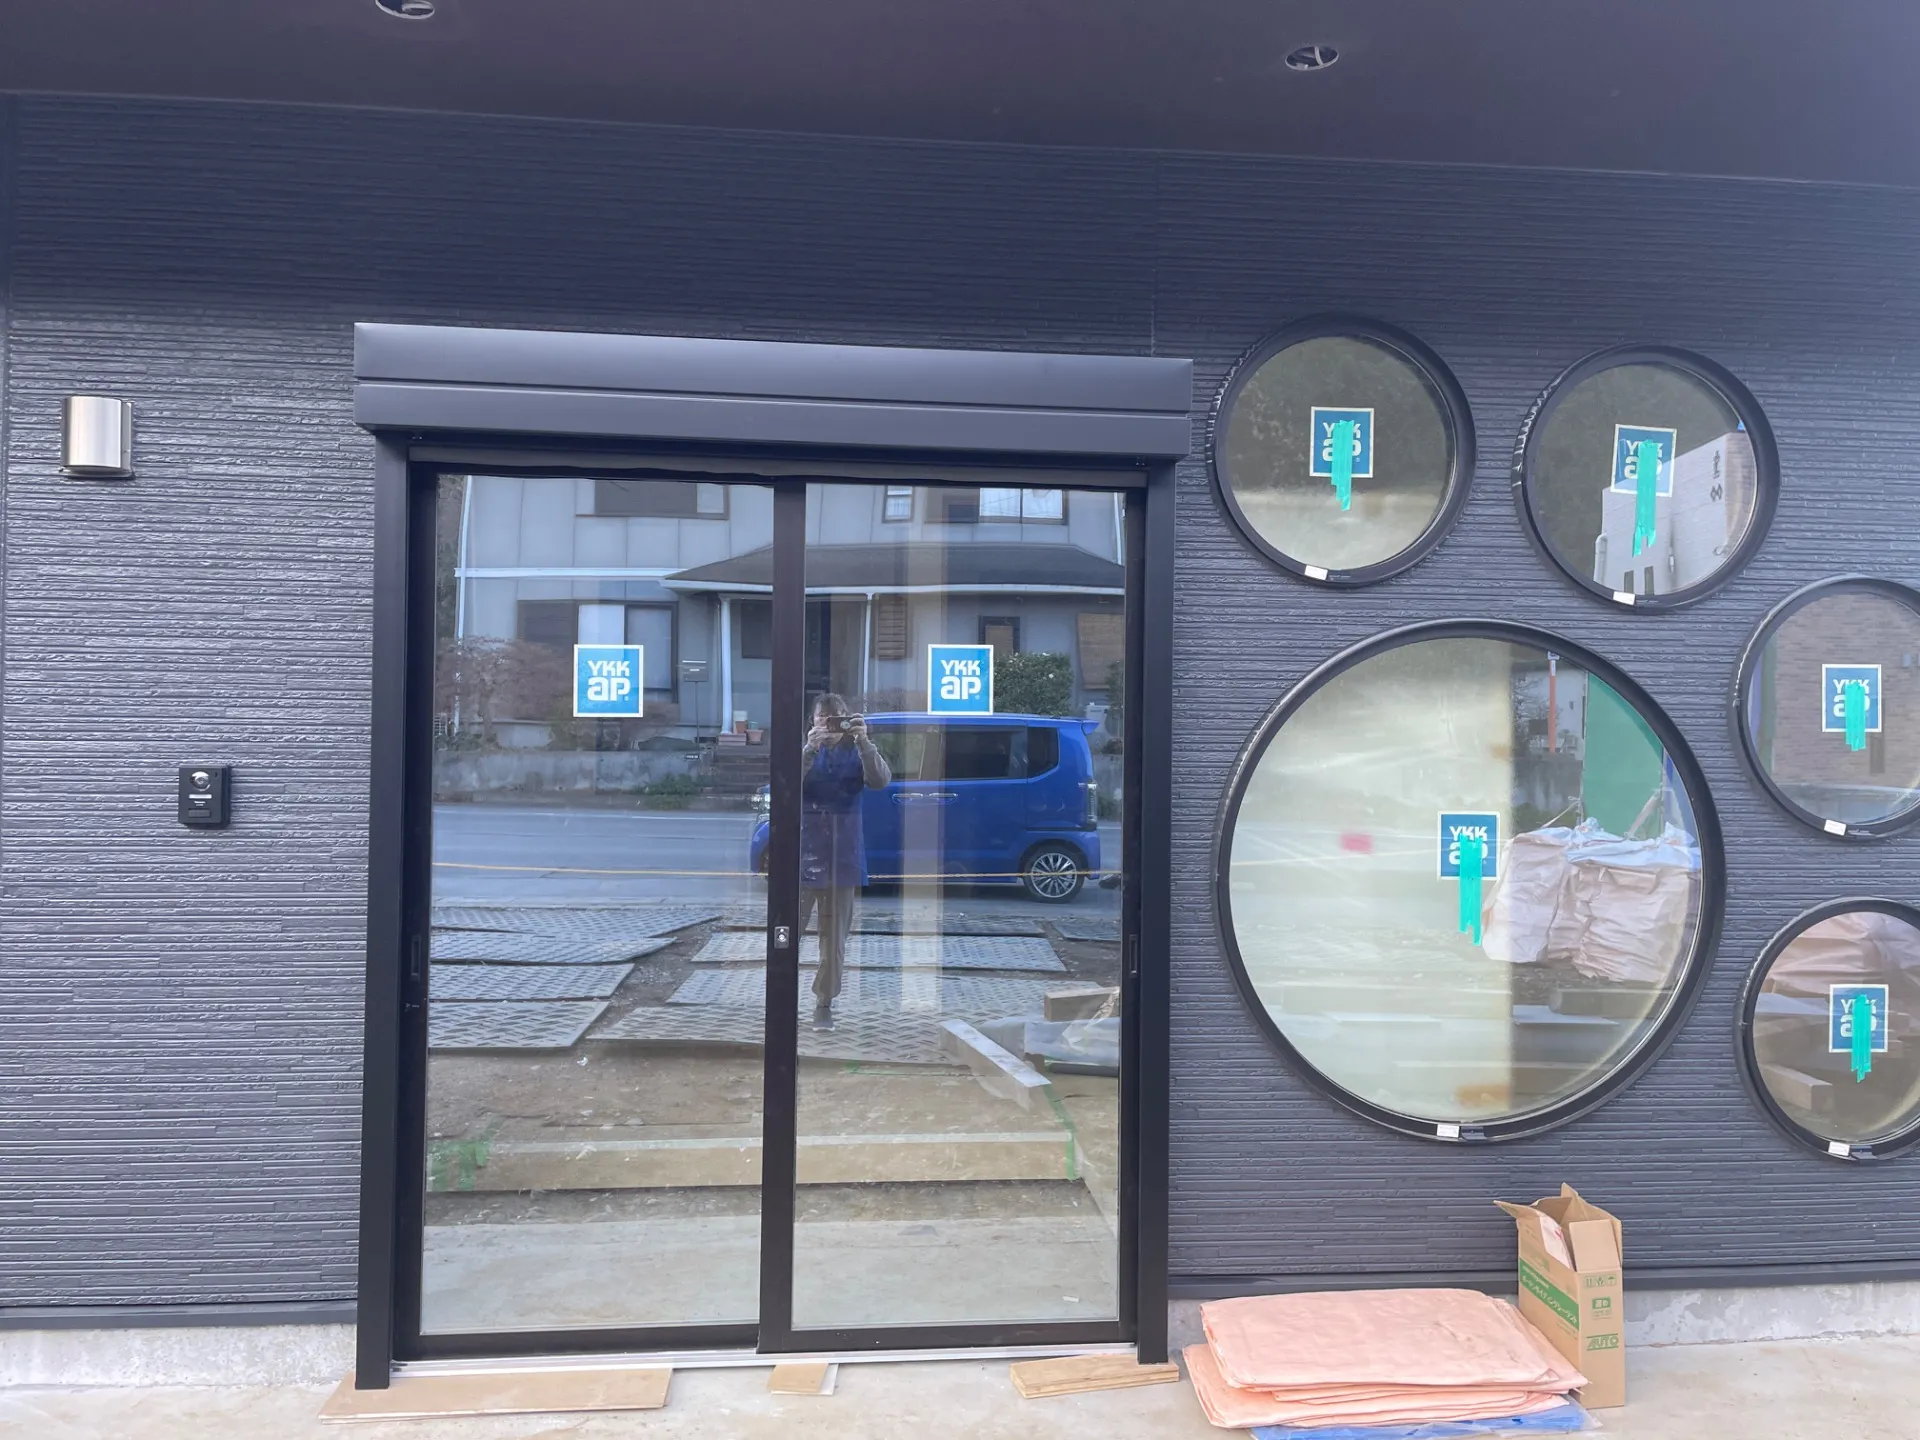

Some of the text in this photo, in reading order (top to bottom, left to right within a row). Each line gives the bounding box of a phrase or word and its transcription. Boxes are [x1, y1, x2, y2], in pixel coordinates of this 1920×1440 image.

[1322, 422, 1361, 439] YK
[586, 660, 631, 677] YKK
[940, 659, 981, 676] YKK
[1833, 694, 1871, 718] a
[1840, 998, 1877, 1014] YK
[1840, 1014, 1878, 1038] a
